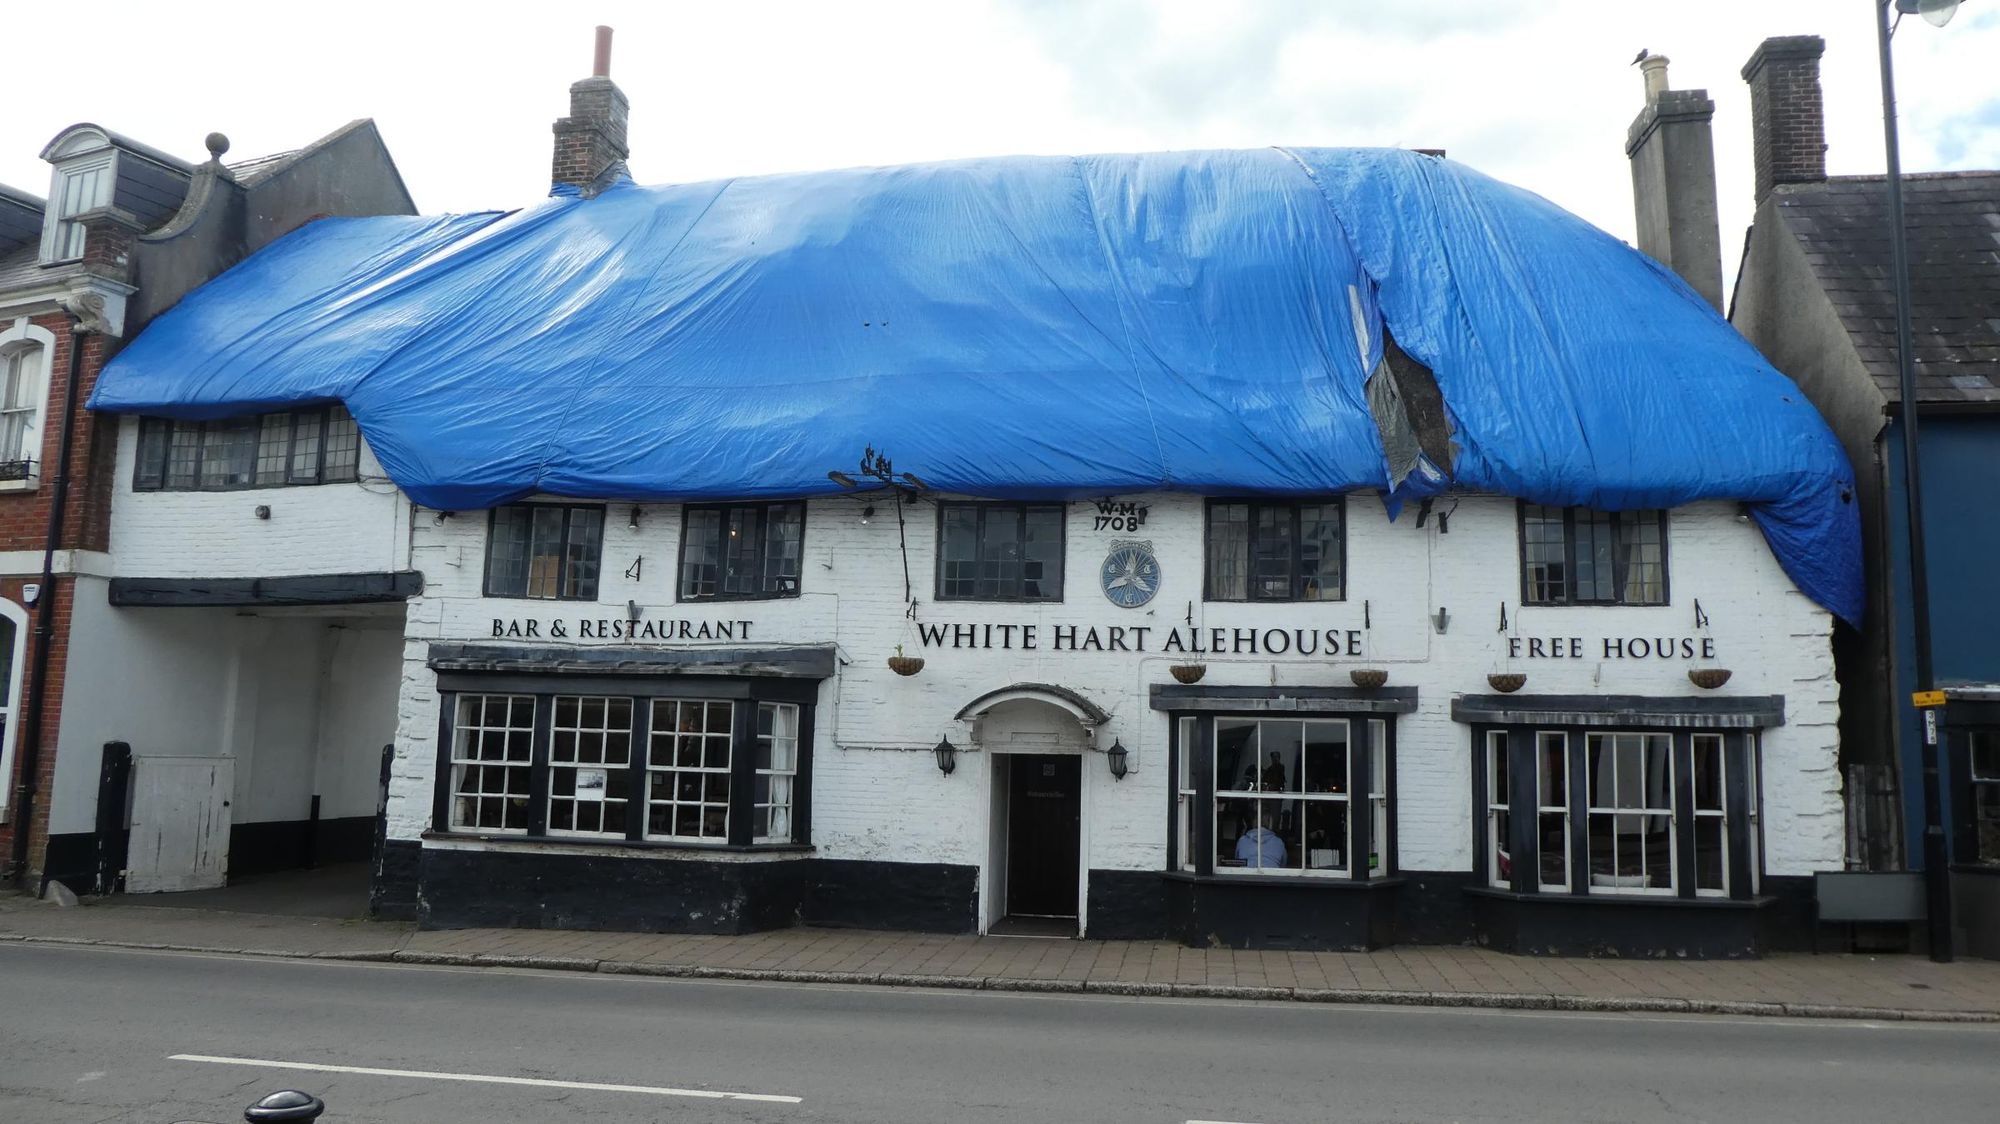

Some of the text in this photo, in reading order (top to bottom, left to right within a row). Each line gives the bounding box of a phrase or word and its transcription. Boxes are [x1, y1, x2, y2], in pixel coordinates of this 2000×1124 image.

[1094, 516, 1138, 532] 1708
[491, 618, 753, 639] BAR & RESTAURANT
[917, 623, 1362, 656] WHITE HART ALEHOUSE
[1508, 637, 1715, 659] FREE HOUSE
